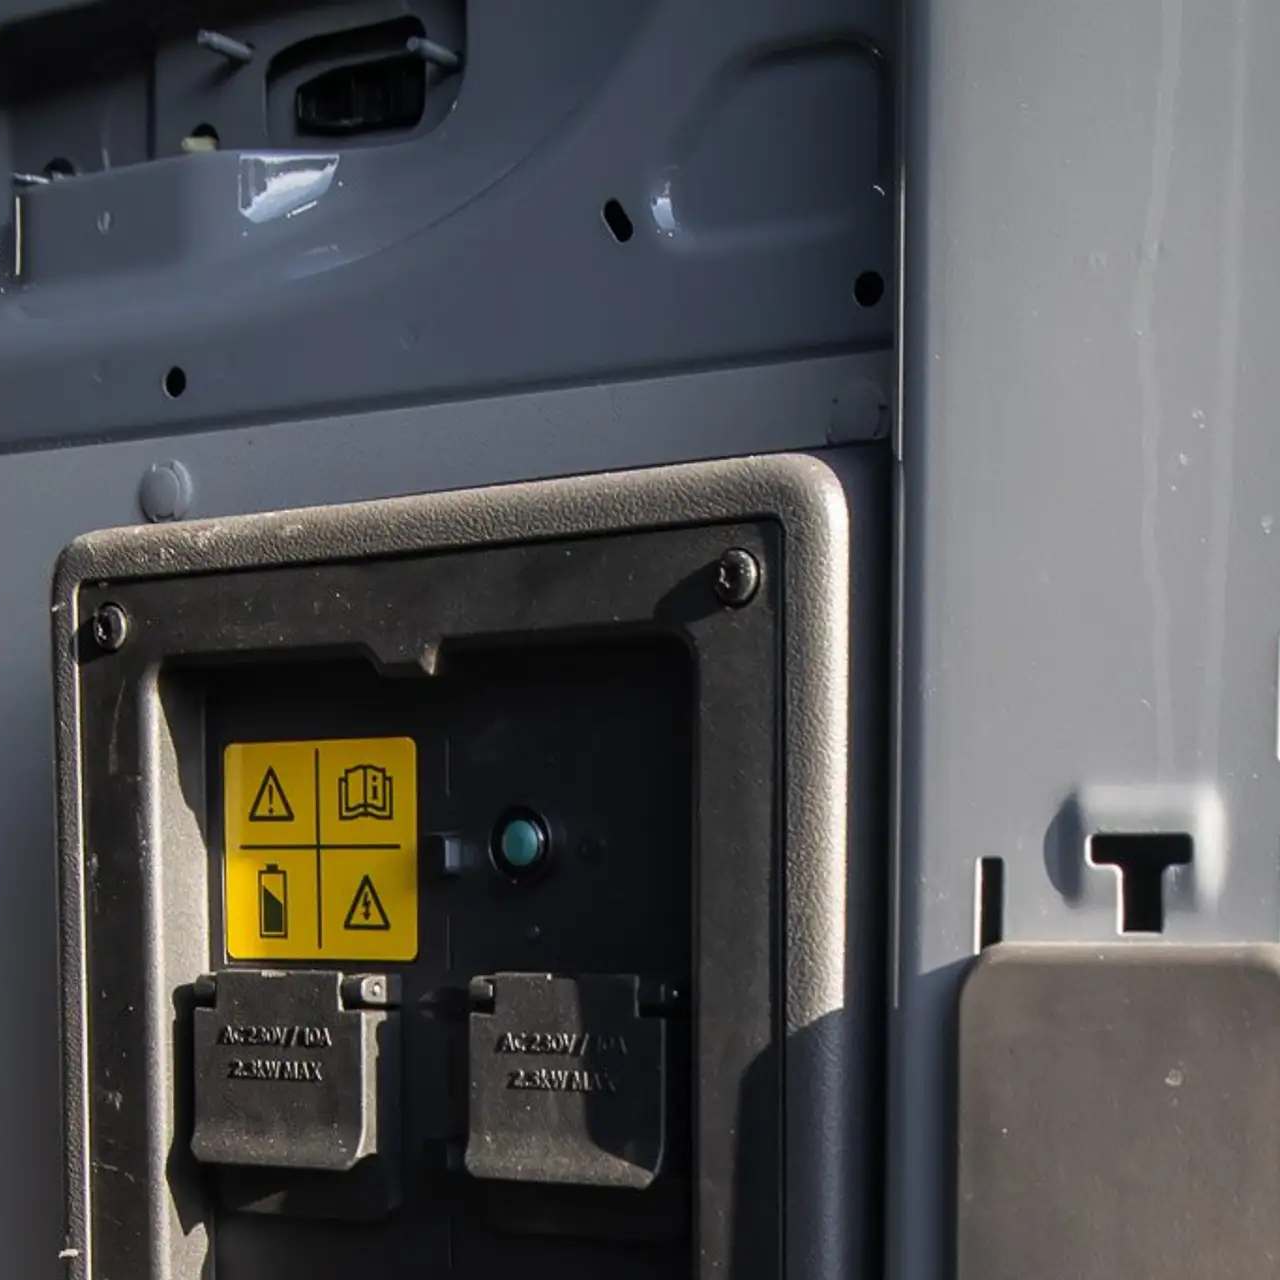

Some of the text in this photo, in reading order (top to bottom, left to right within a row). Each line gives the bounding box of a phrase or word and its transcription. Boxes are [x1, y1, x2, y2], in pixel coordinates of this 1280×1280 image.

[220, 1024, 245, 1044] AC
[246, 1025, 288, 1046] 230V
[500, 1031, 527, 1052] AC
